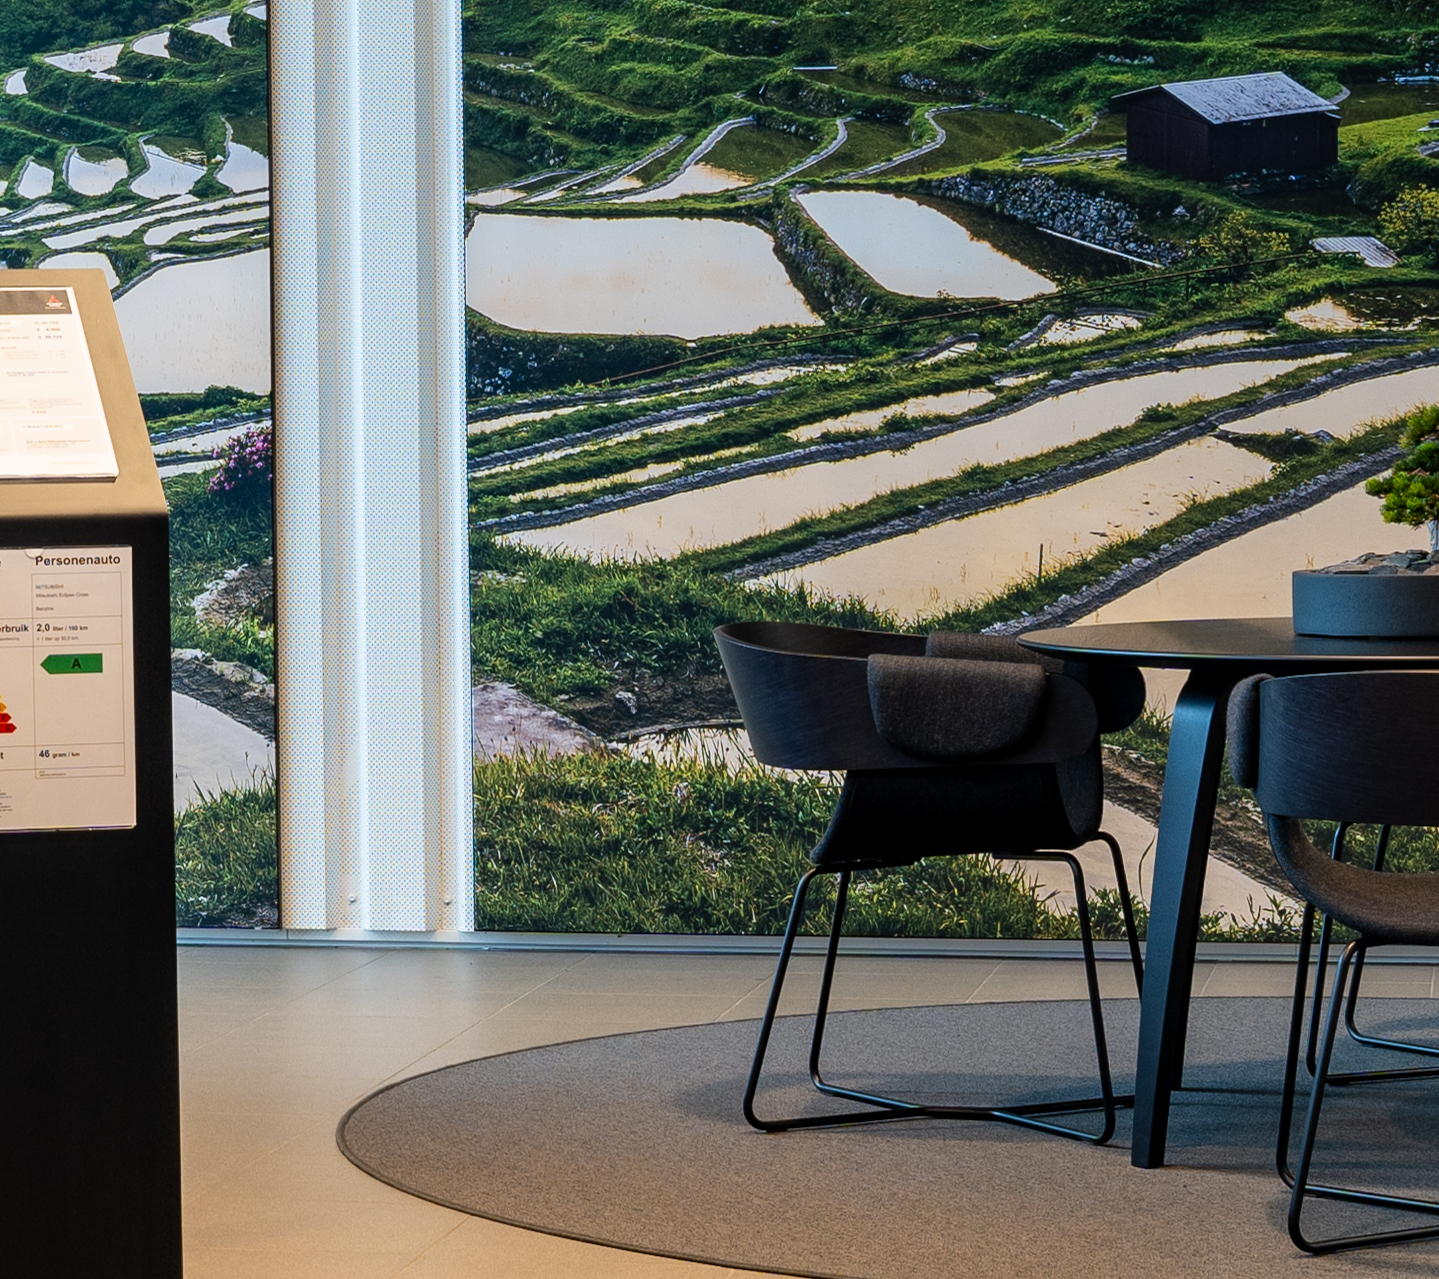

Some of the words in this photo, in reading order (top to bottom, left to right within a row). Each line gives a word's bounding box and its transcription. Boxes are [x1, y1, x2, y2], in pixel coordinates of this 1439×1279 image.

[35, 554, 121, 566] Personenauto
[36, 623, 50, 633] 2,0
[71, 657, 82, 669] A
